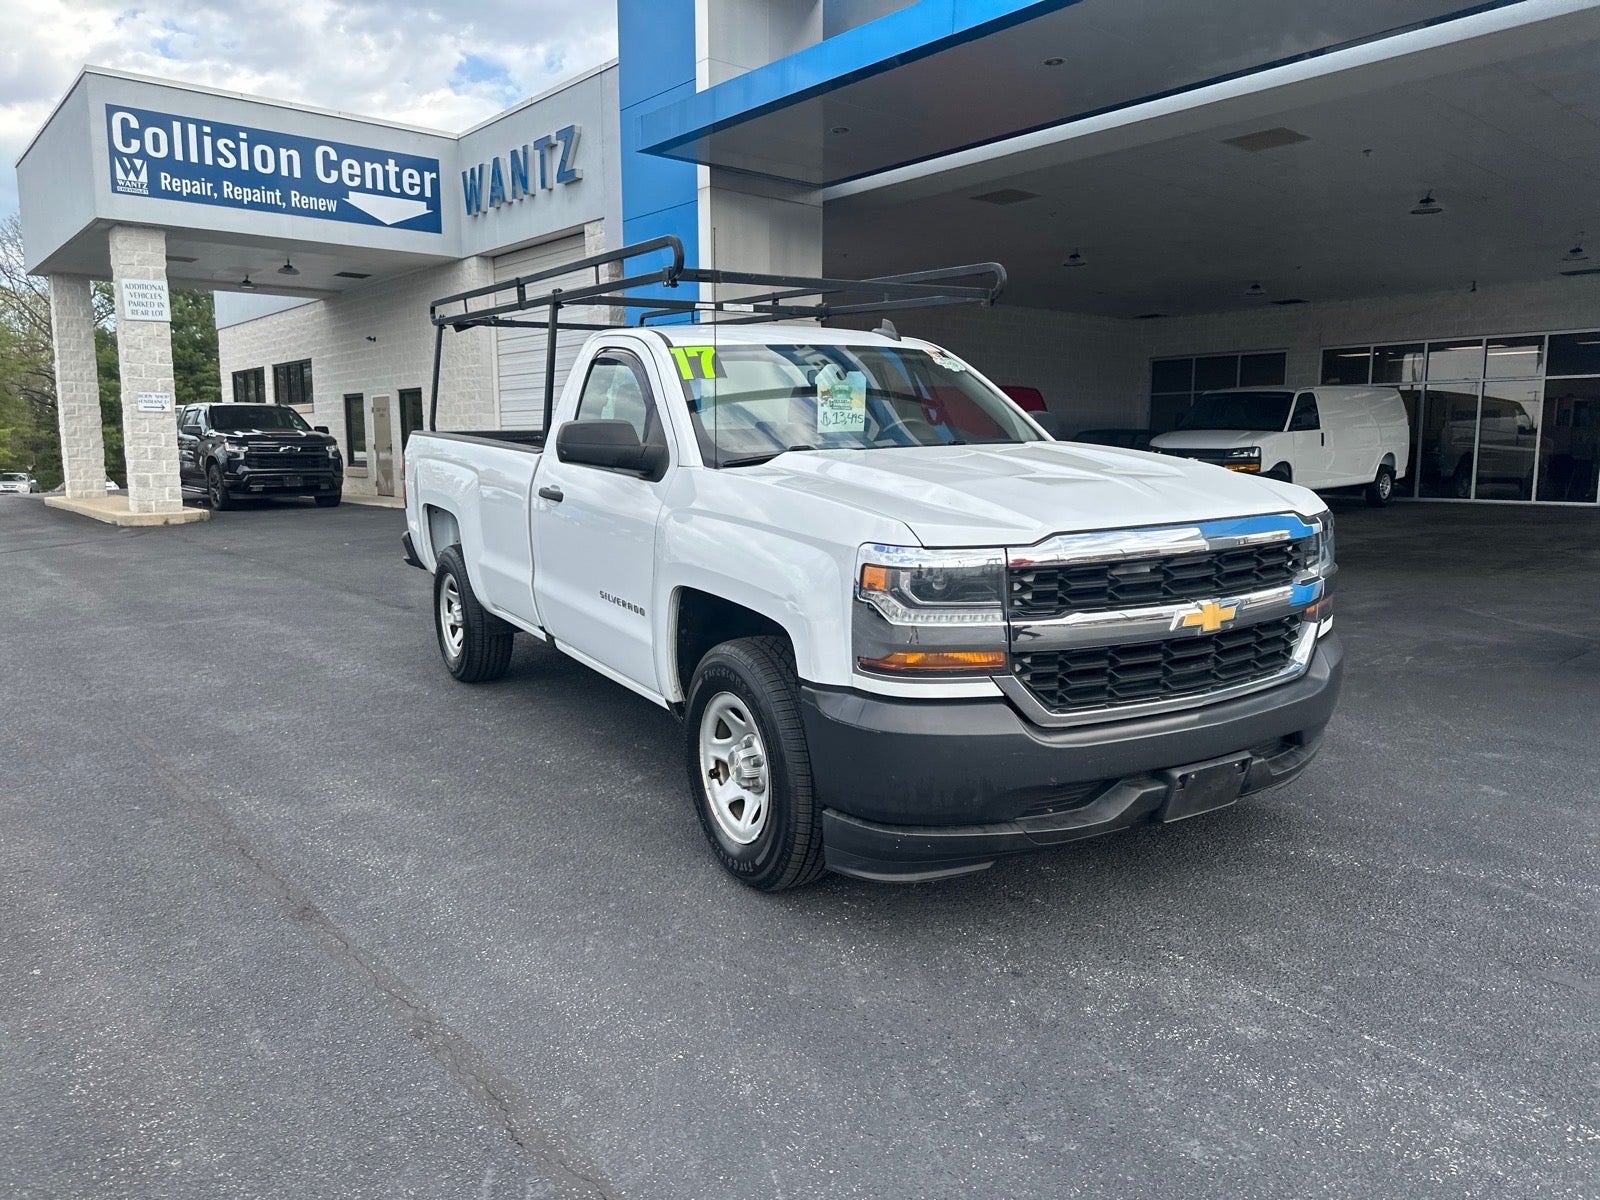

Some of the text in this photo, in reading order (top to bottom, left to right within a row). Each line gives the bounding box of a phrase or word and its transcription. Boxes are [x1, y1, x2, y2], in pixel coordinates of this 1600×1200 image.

[112, 112, 437, 198] Collision Center
[117, 179, 148, 190] WANTZ
[461, 125, 583, 217] WANTZ
[160, 172, 337, 213] Repair, Repaint, Renew
[125, 282, 165, 291] ADDITIONAL
[129, 292, 163, 300] VEHICLES
[127, 300, 156, 308] PARKED
[669, 346, 716, 380] 17
[599, 590, 646, 617] SILVERADO
